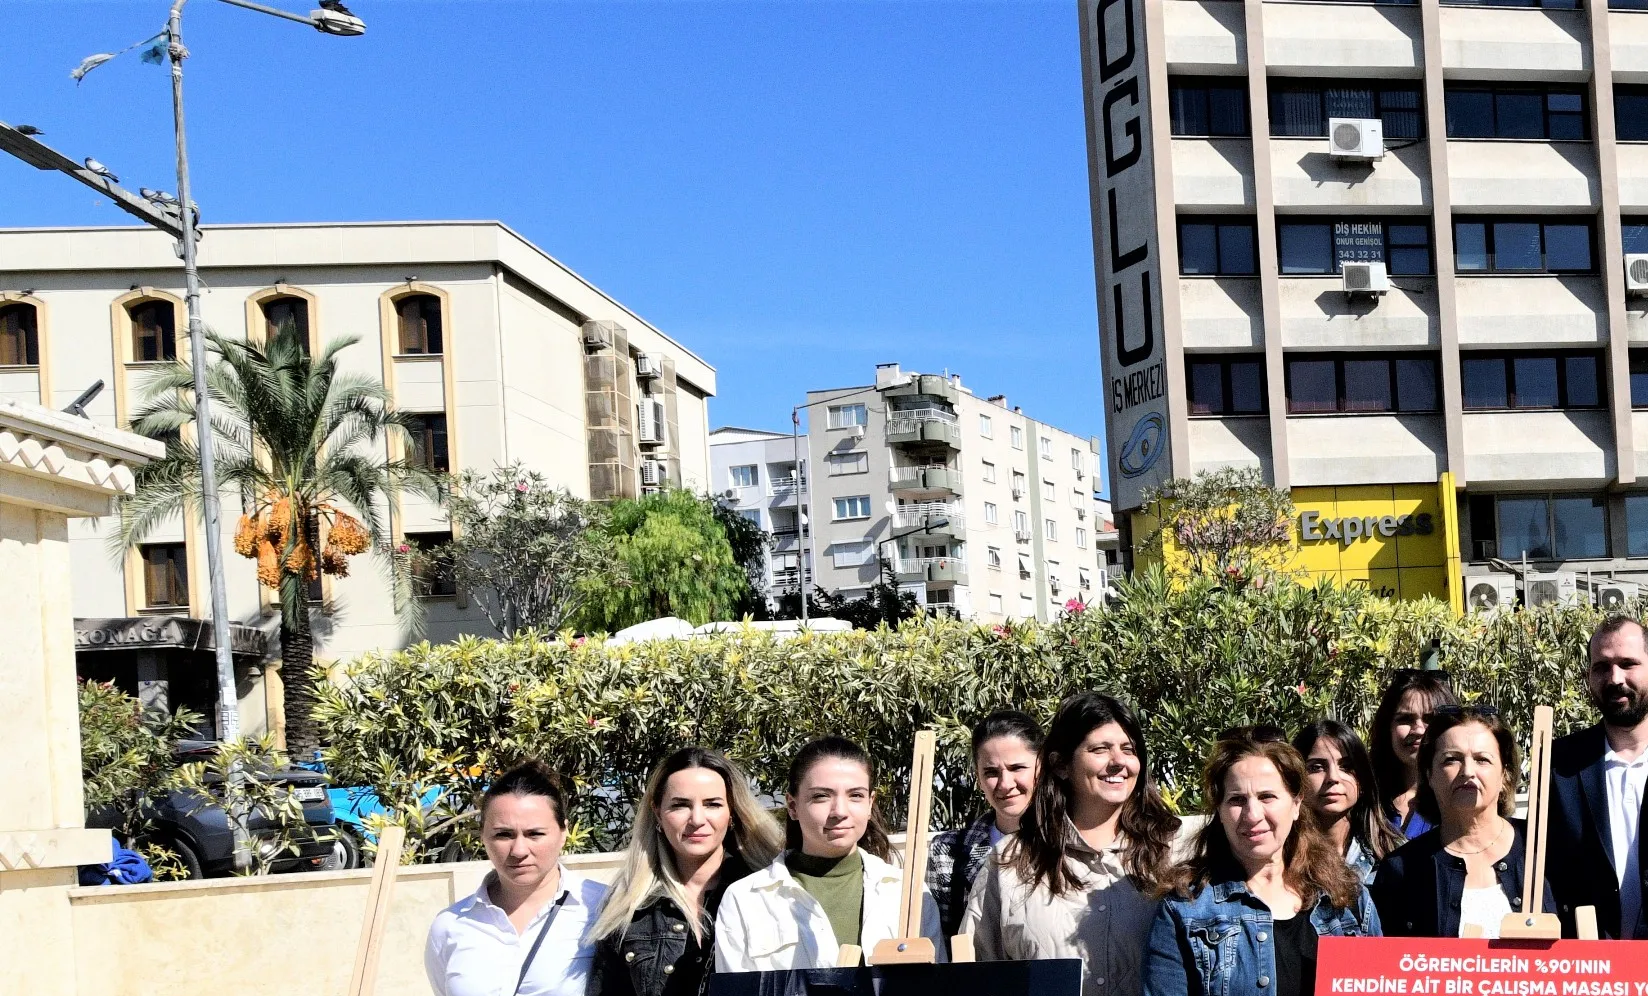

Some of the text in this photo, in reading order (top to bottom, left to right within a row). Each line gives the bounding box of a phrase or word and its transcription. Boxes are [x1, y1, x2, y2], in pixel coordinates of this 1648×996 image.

[1335, 221, 1382, 236] DİŞ HEKİMİ
[1336, 237, 1354, 245] ONUR
[1338, 250, 1381, 259] 343 32 31
[1111, 357, 1164, 413] İŞ MERKEZİ
[1301, 510, 1434, 545] Express
[1399, 953, 1611, 974] ÖĞRENCİLERİN %90'ININ
[1332, 975, 1407, 993] KENDİNE
[1412, 976, 1441, 994] AİT
[1445, 976, 1473, 994] BİR
[1562, 981, 1629, 996] MASASI
